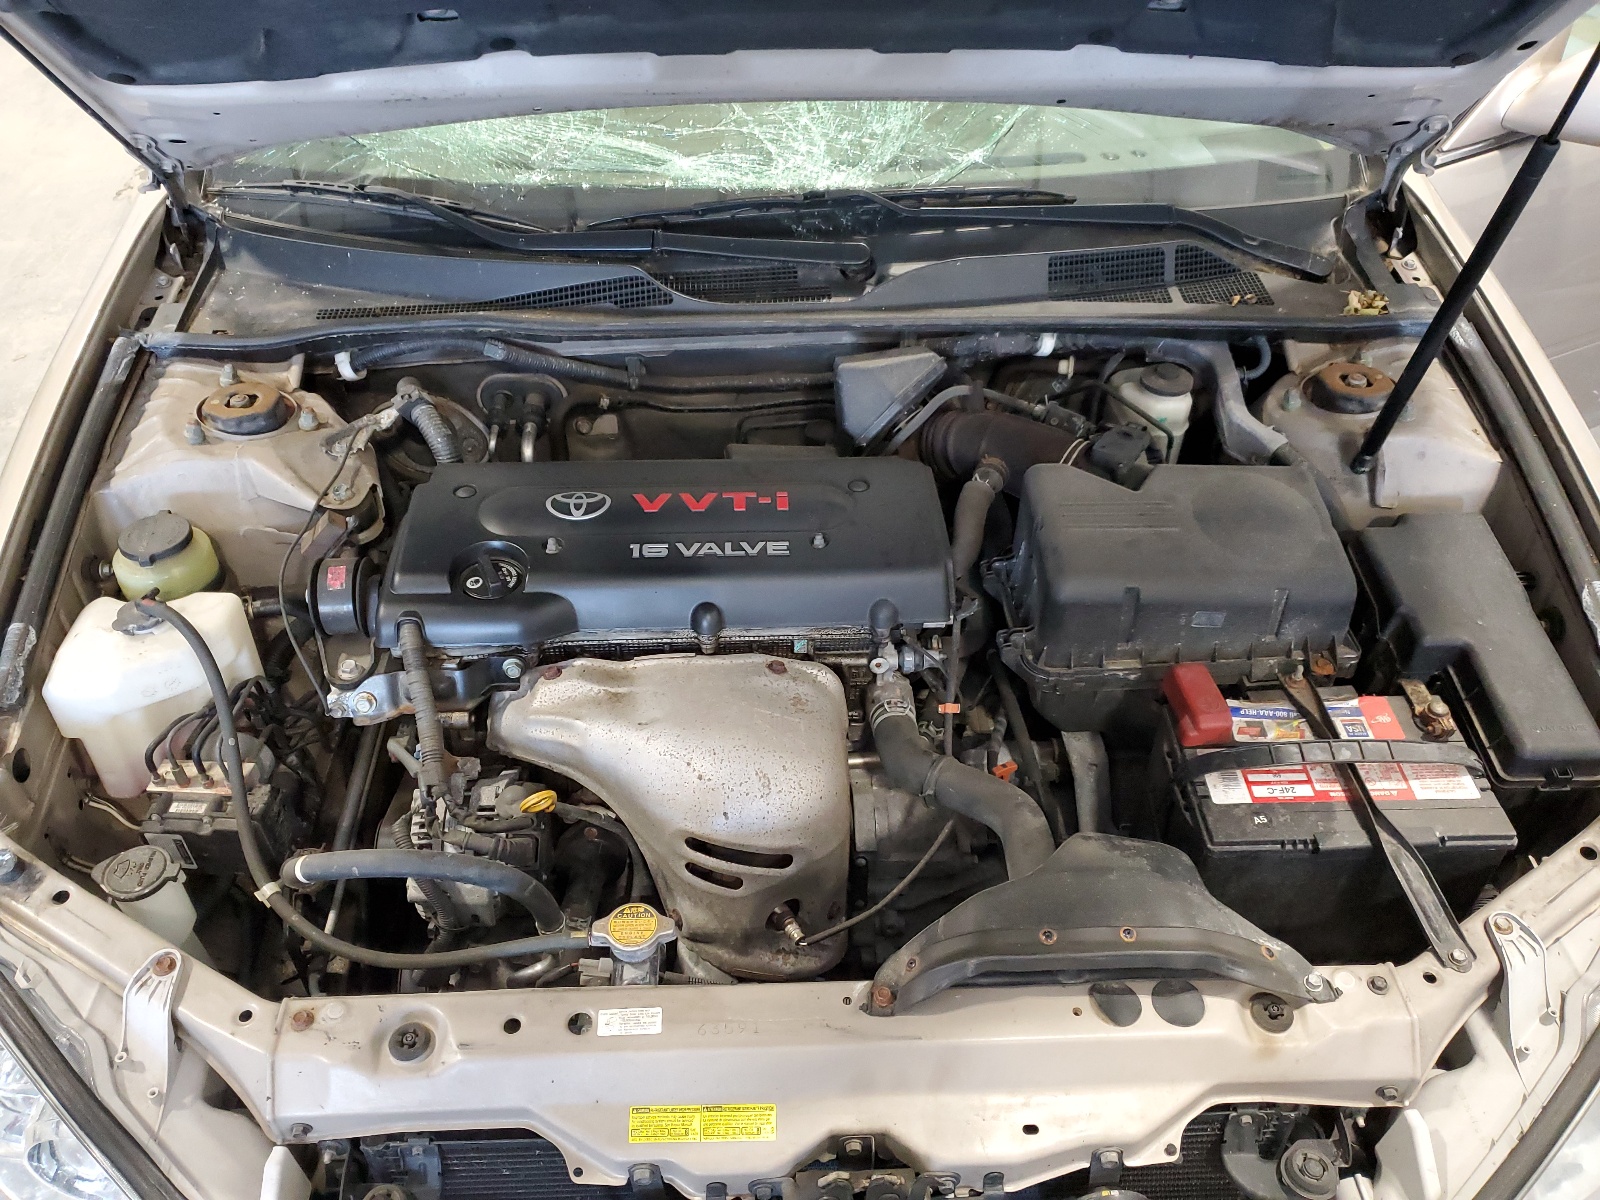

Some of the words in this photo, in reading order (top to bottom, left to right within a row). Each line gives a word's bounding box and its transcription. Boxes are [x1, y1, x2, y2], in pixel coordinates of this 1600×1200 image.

[633, 491, 789, 512] VVT-i
[629, 542, 668, 558] 16
[674, 541, 790, 558] VALVE
[1345, 724, 1366, 733] USA
[1267, 786, 1297, 795] 24F-C
[1253, 815, 1268, 825] A5
